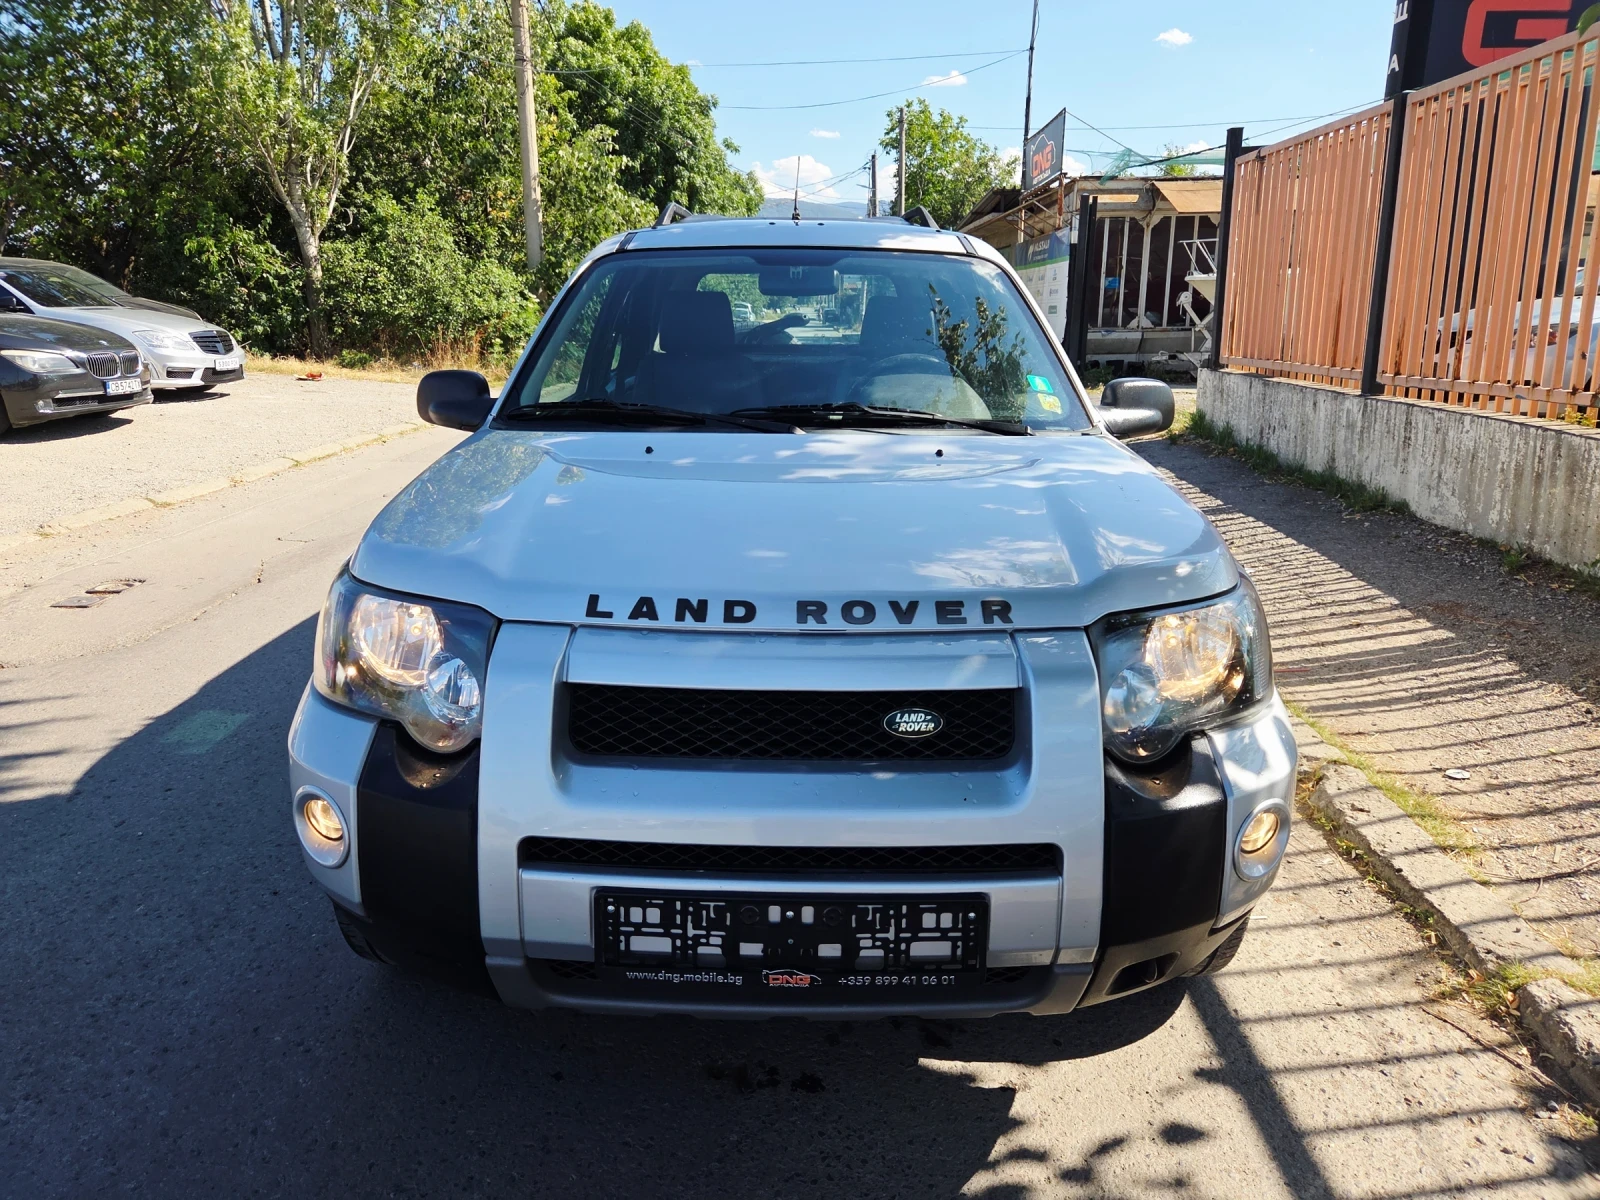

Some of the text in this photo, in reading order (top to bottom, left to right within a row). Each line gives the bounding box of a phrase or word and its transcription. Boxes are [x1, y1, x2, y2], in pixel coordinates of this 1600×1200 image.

[1032, 144, 1053, 178] DNG
[586, 594, 1014, 625] LAND ROVER
[895, 713, 926, 722] LAND
[898, 722, 935, 732] ROVER
[626, 970, 743, 986] www.dng.mobile.bg
[769, 975, 811, 985] DNG
[838, 976, 956, 986] +359 899 41 06 01
